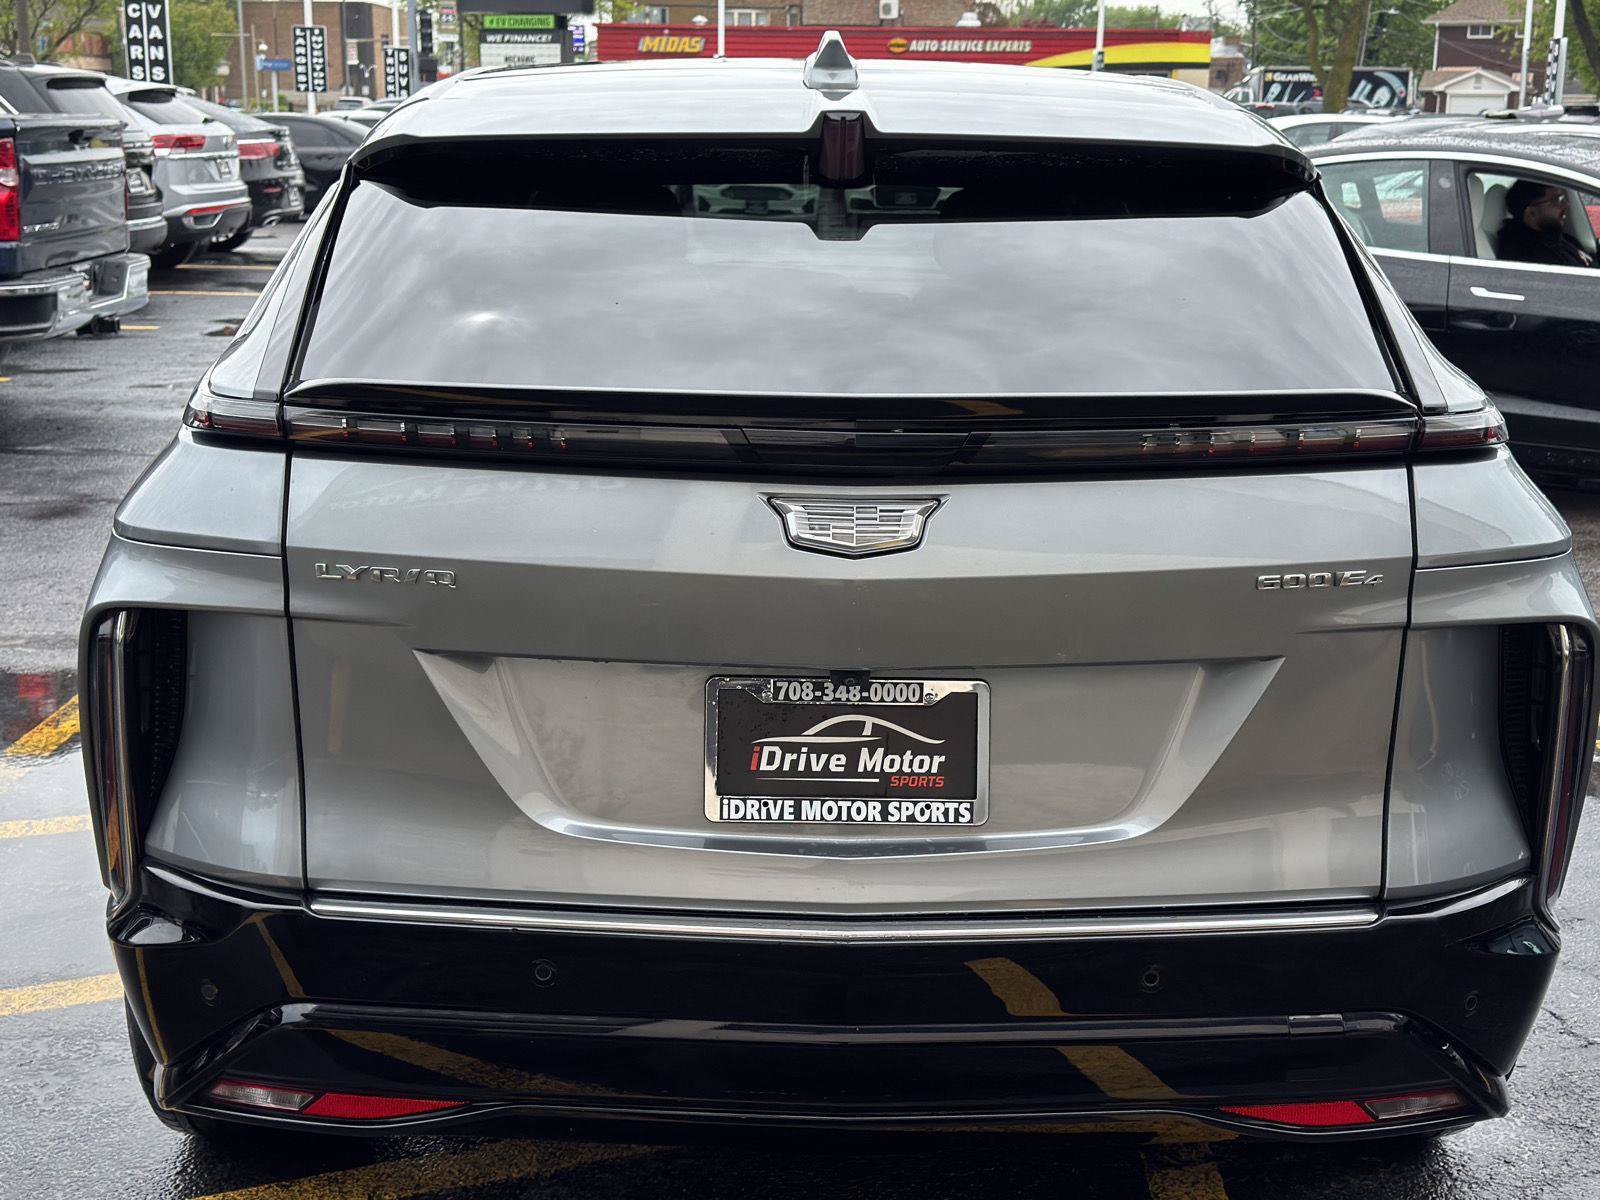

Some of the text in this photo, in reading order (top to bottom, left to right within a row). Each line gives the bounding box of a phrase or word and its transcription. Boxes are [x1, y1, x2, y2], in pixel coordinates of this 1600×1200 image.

[127, 3, 145, 80] CARS
[147, 4, 165, 81] VANS
[486, 34, 552, 42] WE FINANCE!
[639, 29, 706, 53] MIDAS
[909, 39, 1032, 52] AUTO SERVICE EXPERTS
[295, 28, 308, 92] LARGEST
[776, 681, 921, 702] 708-348-0000
[750, 745, 946, 774] iDrive Motor
[890, 775, 945, 788] SPORTS
[722, 799, 971, 823] iDRIVE MOTOR SPORTS
